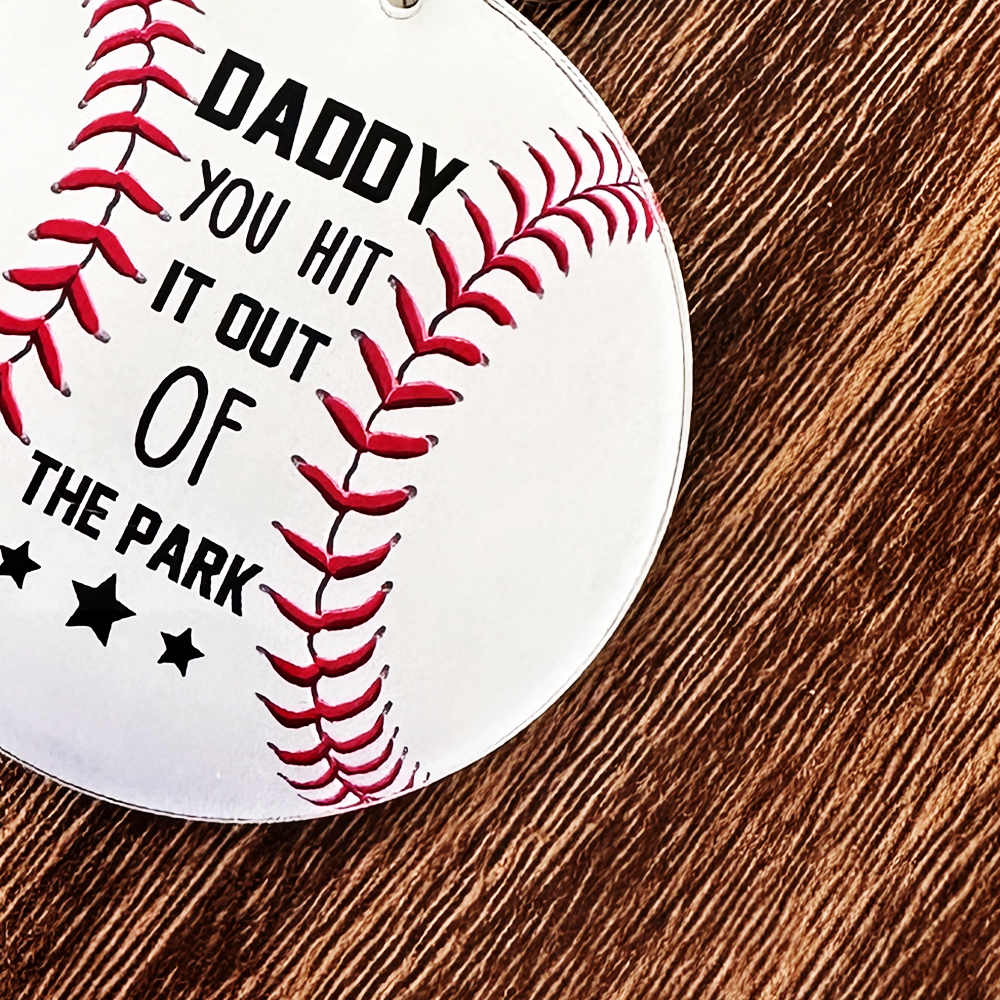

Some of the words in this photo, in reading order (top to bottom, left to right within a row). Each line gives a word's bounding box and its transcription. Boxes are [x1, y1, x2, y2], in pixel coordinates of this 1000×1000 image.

[195, 48, 469, 225] DADDY
[180, 159, 291, 254] YOU
[298, 219, 393, 305] HIT
[150, 259, 216, 324] IT
[215, 292, 332, 383] OUT
[135, 365, 257, 487] OF
[21, 449, 119, 541] THE
[114, 502, 264, 617] PARK
